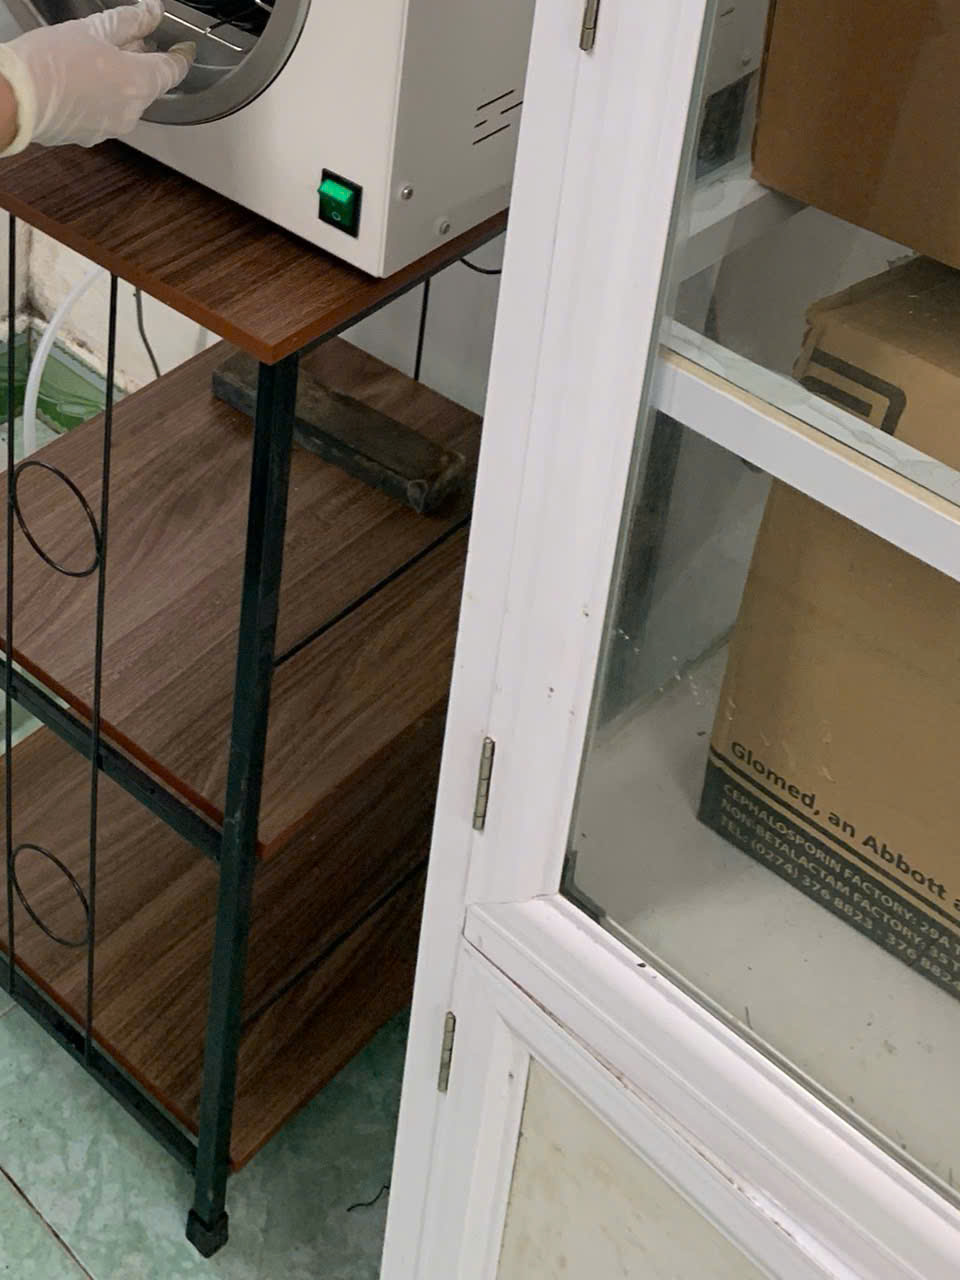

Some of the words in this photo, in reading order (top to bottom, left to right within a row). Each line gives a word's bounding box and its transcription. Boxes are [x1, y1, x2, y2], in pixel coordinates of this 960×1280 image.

[724, 784, 841, 873] CEPHALOSPORIN
[844, 868, 916, 925] FACTORY:
[731, 741, 820, 815] Glomed,
[828, 812, 856, 838] an
[862, 835, 948, 900] Abbott
[854, 892, 926, 950] FACTORY:
